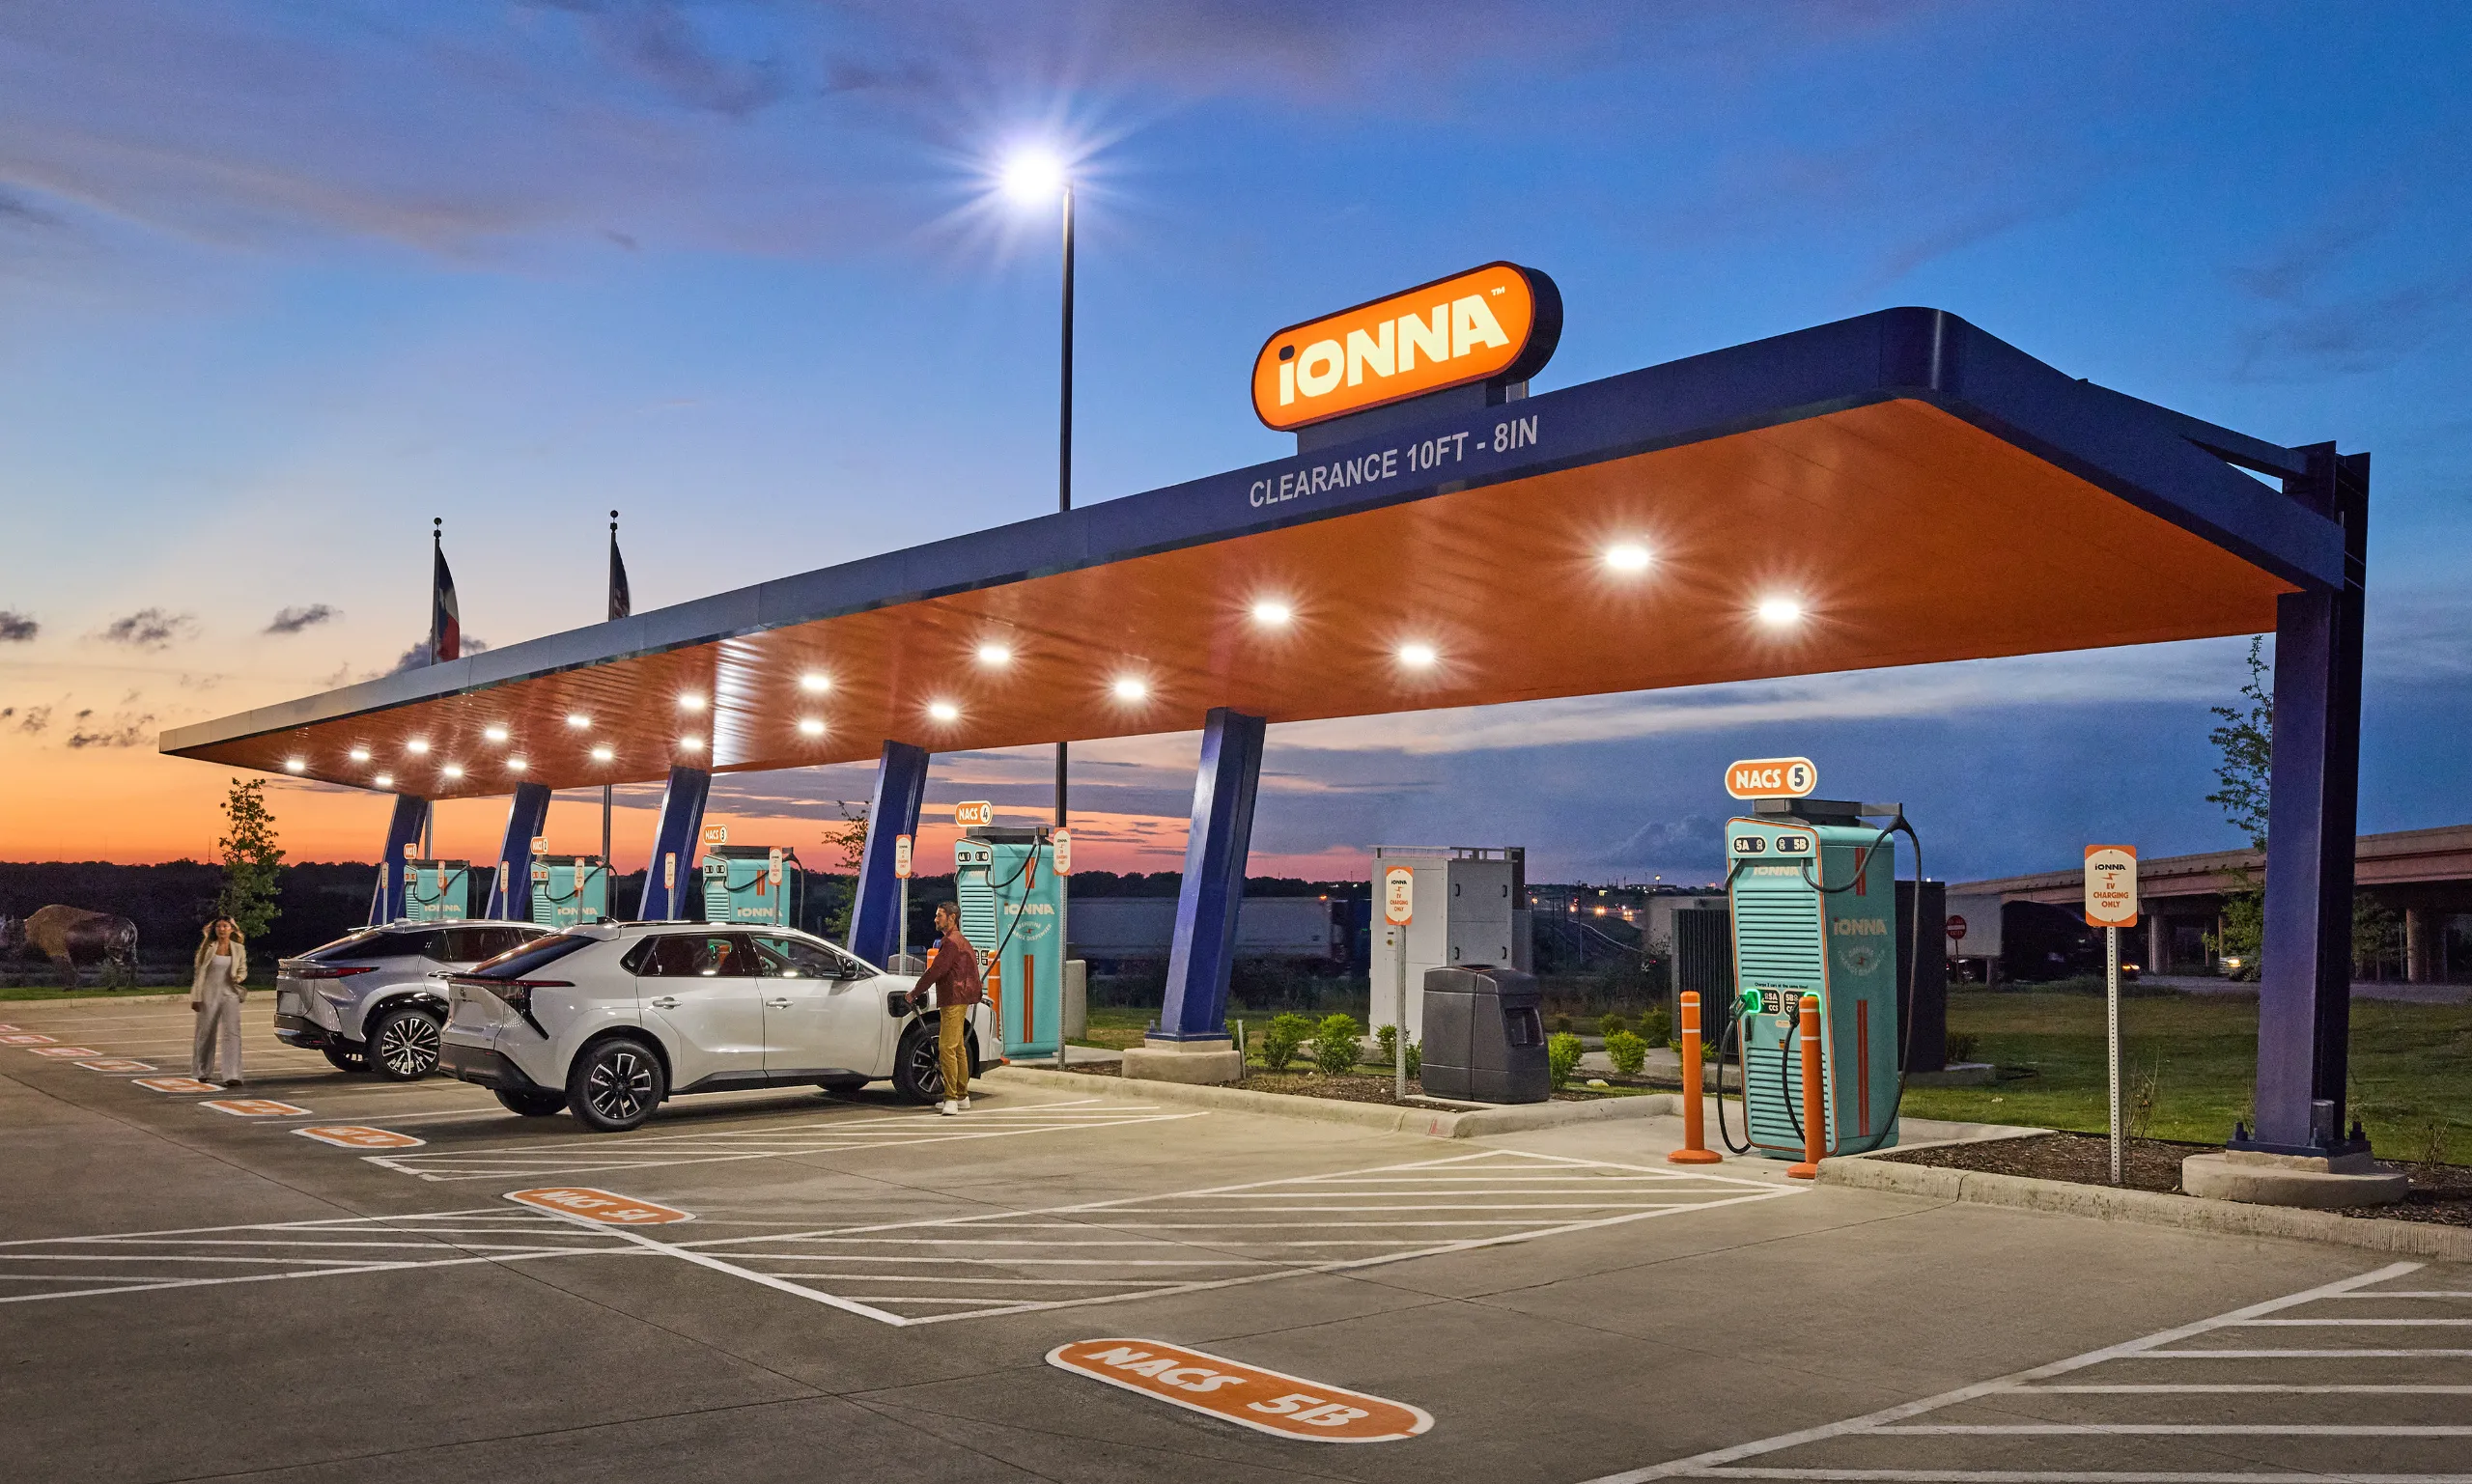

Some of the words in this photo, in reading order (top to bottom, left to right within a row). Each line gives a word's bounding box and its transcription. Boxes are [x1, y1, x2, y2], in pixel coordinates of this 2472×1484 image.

[1278, 294, 1510, 406] iONNA
[1250, 448, 1398, 508] CLEARANCE
[1406, 431, 1469, 472] 10FT
[1493, 414, 1538, 453] 8IN
[1735, 769, 1782, 789] NACS
[1793, 767, 1805, 788] 5
[959, 807, 978, 821] NACS
[982, 807, 988, 821] 4
[706, 829, 718, 840] NACS
[1735, 839, 1750, 852] 5A
[1793, 838, 1807, 851] 5B
[1834, 917, 1888, 936] iONNA
[1083, 1345, 1249, 1393] NACS
[1248, 1392, 1369, 1427] 5B
